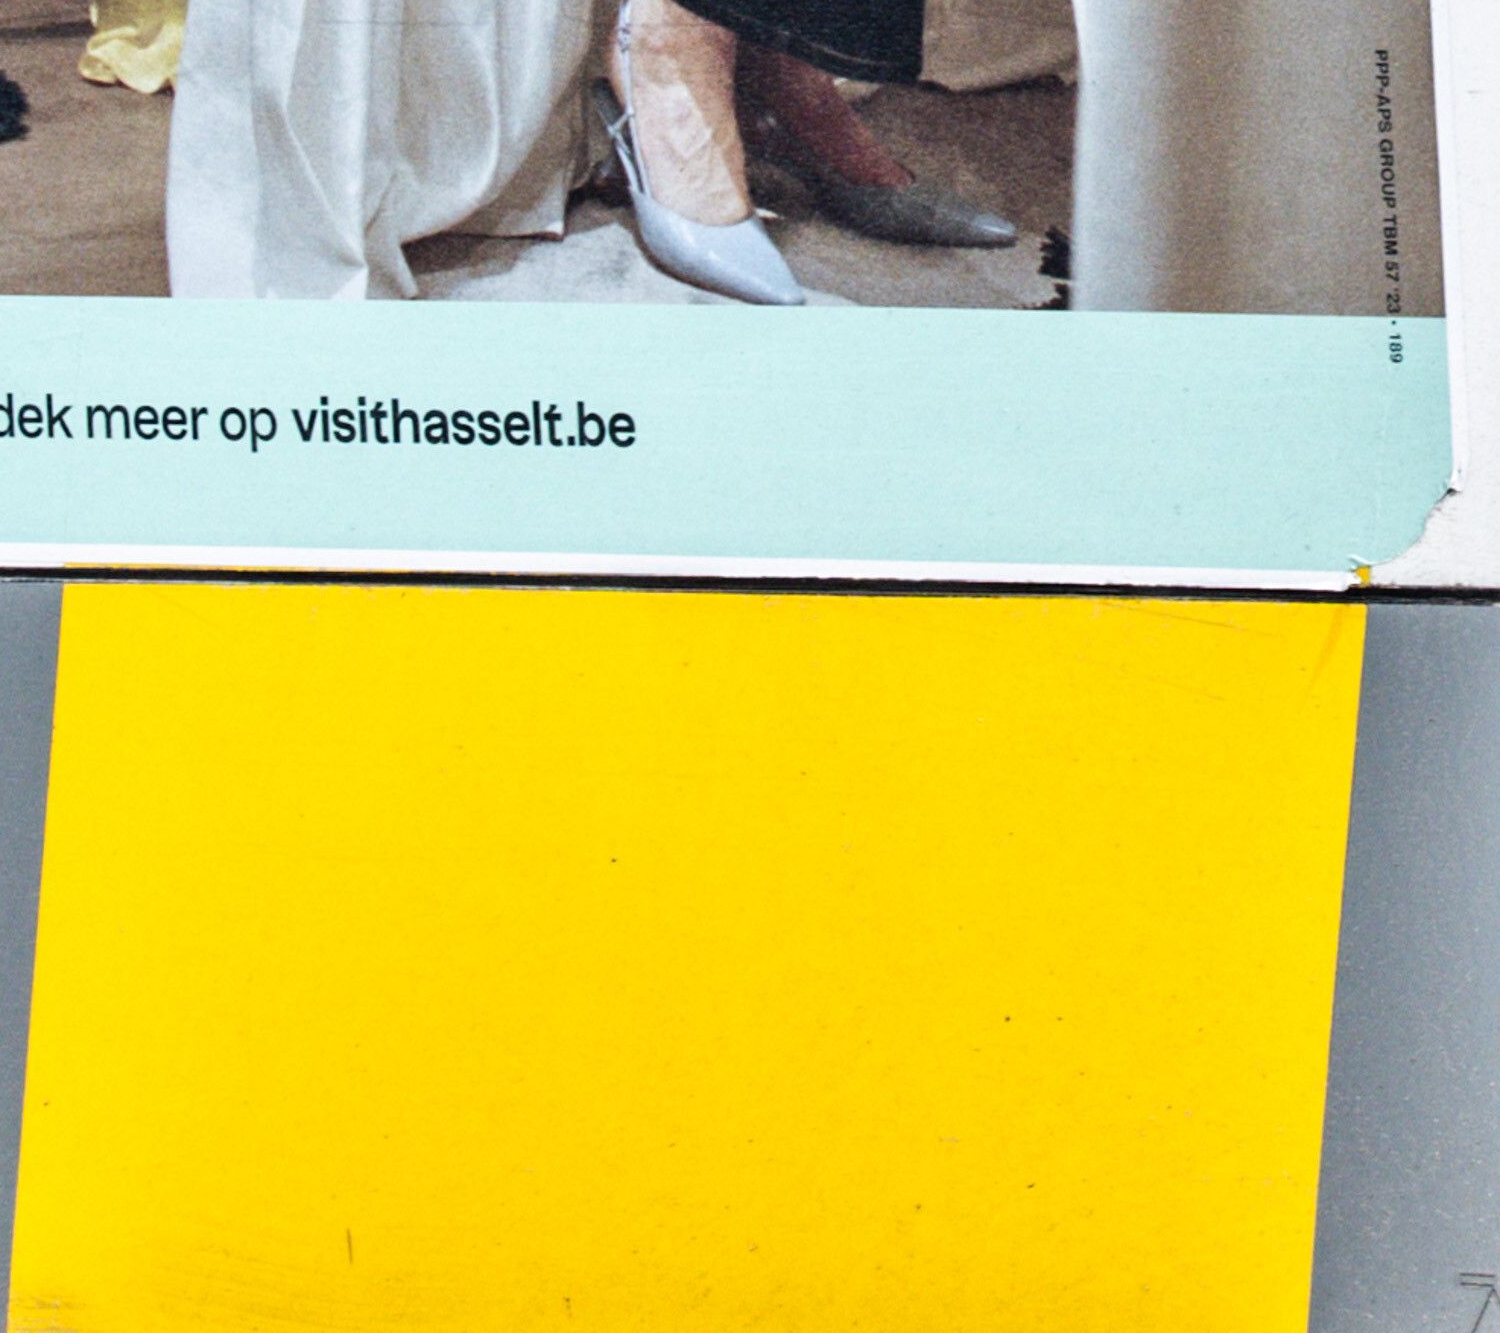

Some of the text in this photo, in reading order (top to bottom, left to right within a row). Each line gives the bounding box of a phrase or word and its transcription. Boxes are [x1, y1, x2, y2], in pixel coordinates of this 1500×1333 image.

[1375, 49, 1392, 133] PPP-APS
[1379, 138, 1397, 209] GROUP
[1383, 215, 1399, 256] TBM
[1384, 260, 1400, 283] 57
[86, 404, 209, 440] meer
[219, 405, 279, 452] op
[291, 396, 638, 450] visithasselt.be
